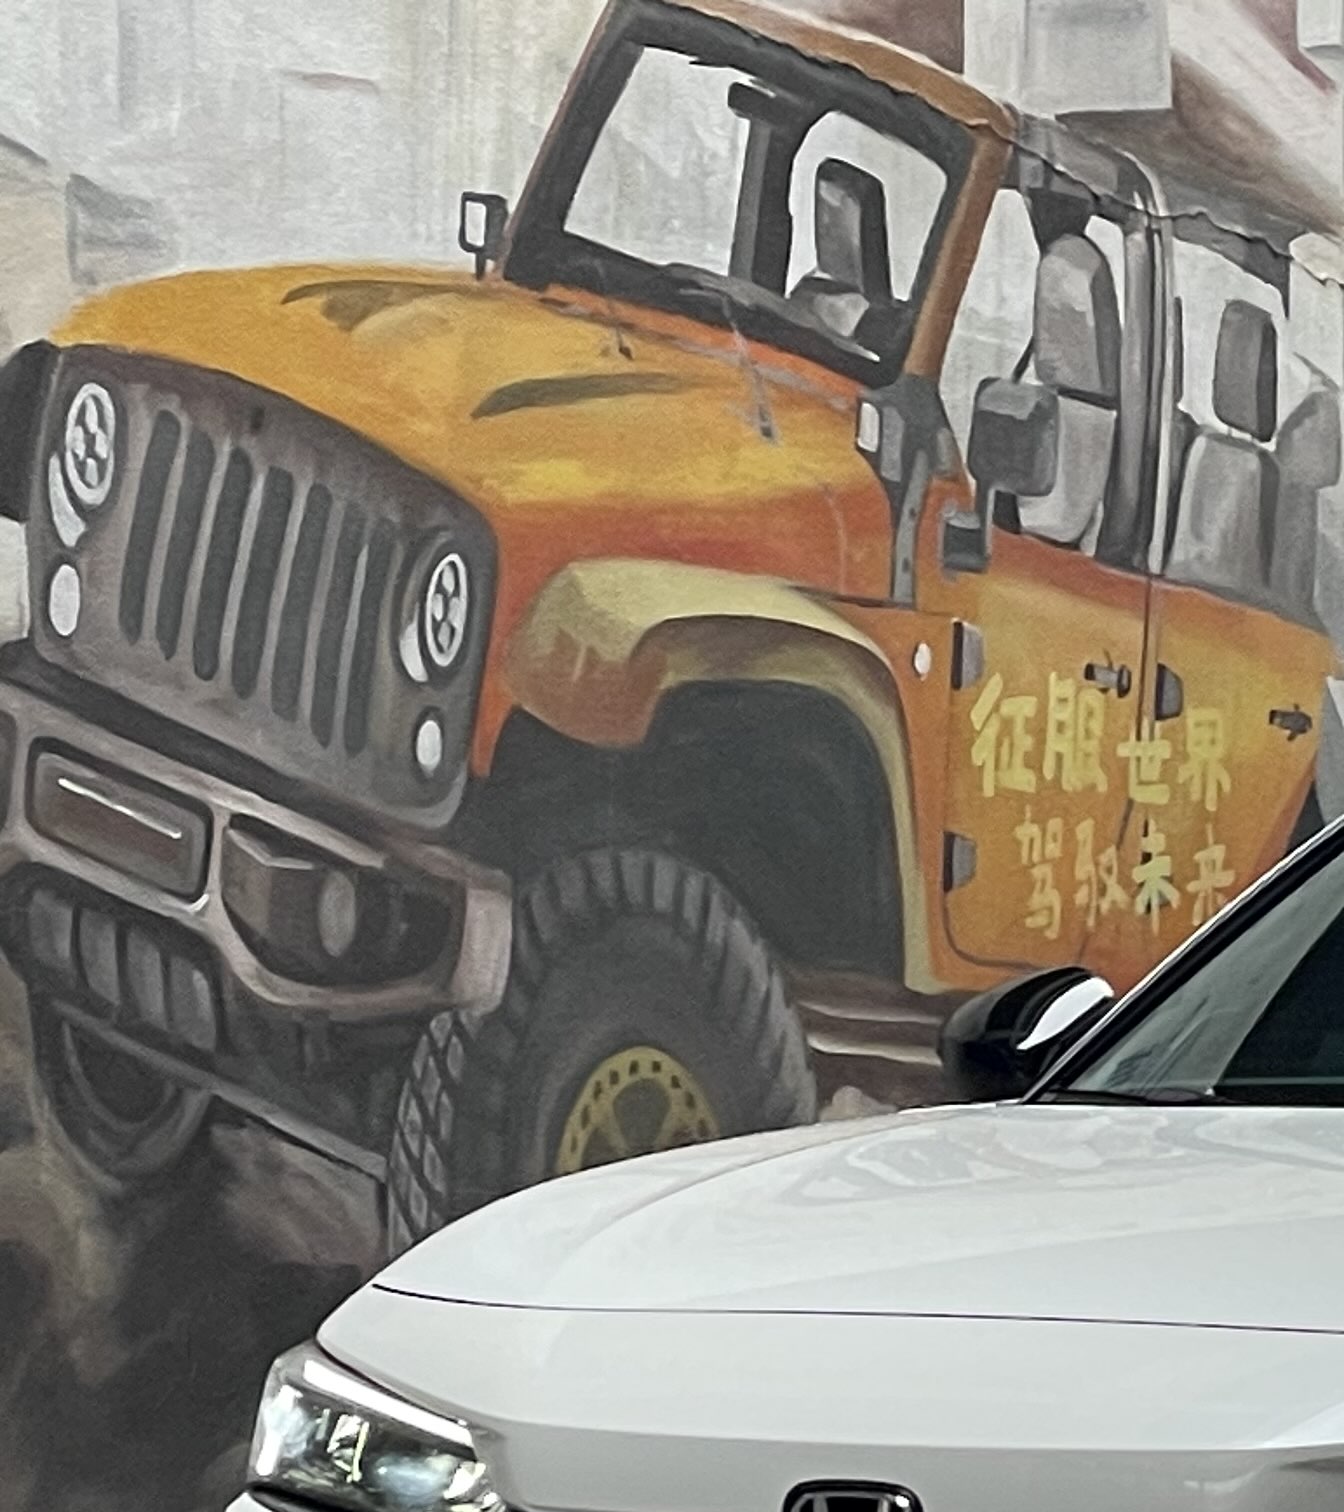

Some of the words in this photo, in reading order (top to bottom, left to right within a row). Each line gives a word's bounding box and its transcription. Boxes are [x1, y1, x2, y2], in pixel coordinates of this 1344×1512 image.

[971, 671, 1231, 811] 征服世界
[1015, 804, 1235, 939] 驾驭未来
